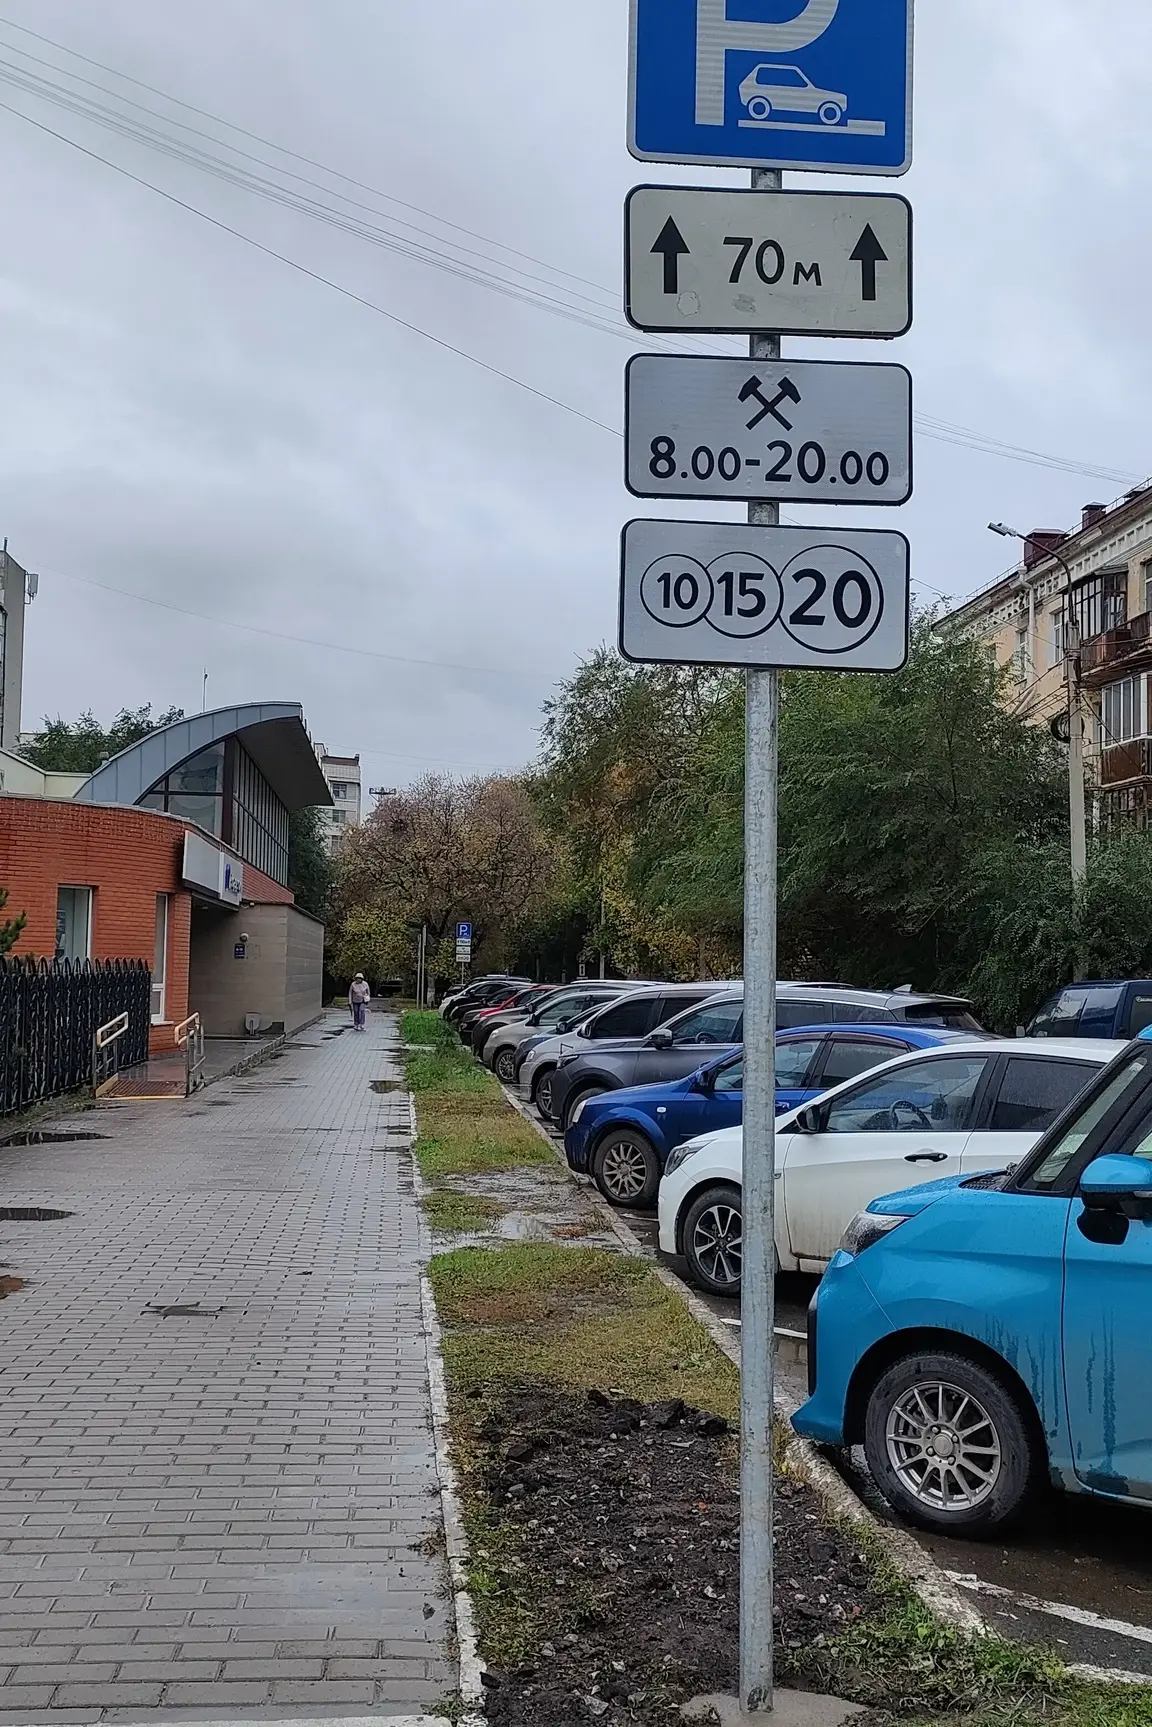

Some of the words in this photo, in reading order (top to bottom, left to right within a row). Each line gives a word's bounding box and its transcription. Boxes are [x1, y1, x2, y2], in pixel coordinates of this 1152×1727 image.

[694, 0, 840, 126] P
[656, 572, 699, 610] 10
[716, 571, 766, 618] 15
[789, 568, 872, 628] 20
[459, 924, 468, 936] P
